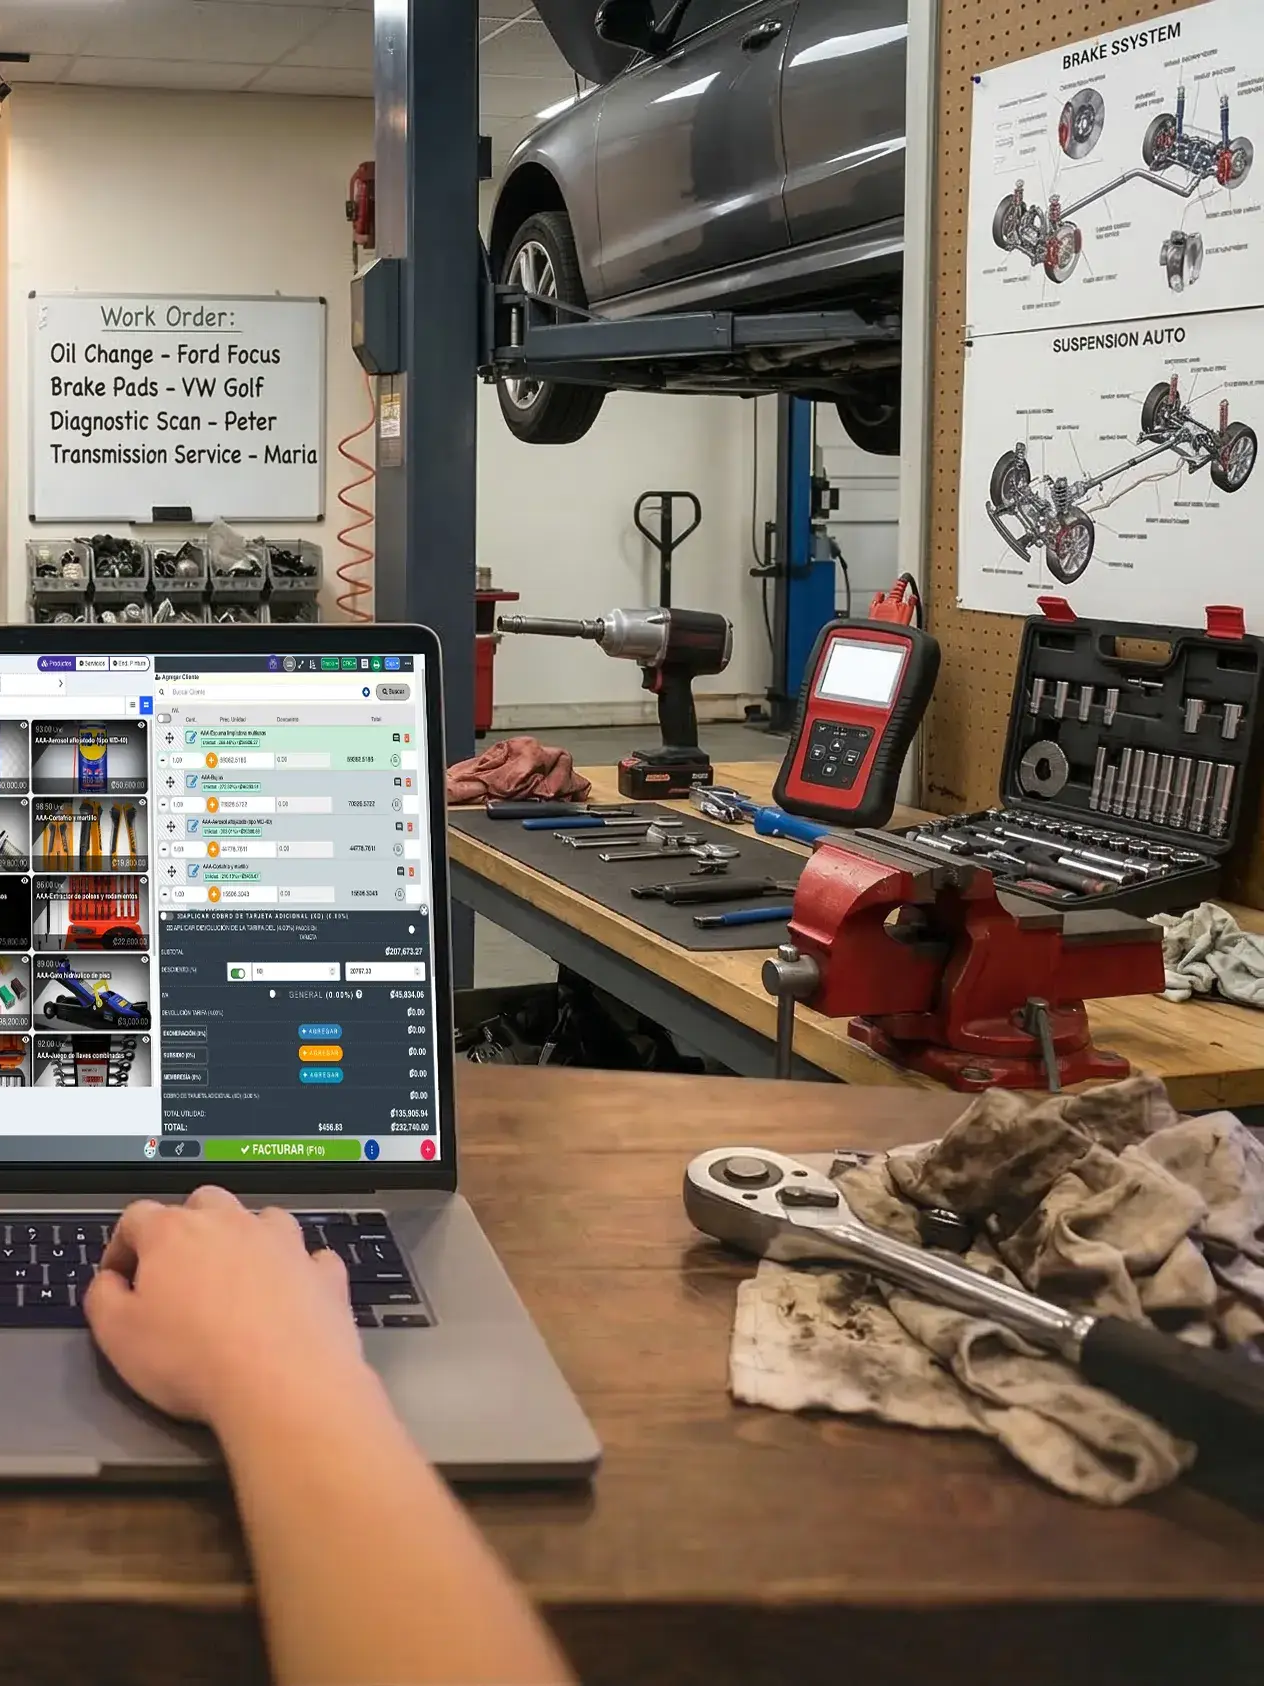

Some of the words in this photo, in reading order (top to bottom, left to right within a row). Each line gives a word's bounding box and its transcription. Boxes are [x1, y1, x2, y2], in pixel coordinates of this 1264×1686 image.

[1063, 40, 1108, 70] BRAKE
[1111, 22, 1181, 56] SSYSTEM
[101, 305, 155, 327] Work
[166, 306, 235, 327] Order:
[1053, 332, 1139, 353] SUSPENSION
[1143, 327, 1186, 345] AUTO
[51, 343, 76, 364] Oil
[85, 344, 154, 370] Change
[178, 344, 220, 364] Ford
[228, 345, 281, 364] Focus
[51, 376, 106, 397] Brake
[113, 376, 158, 397] Pads
[182, 377, 216, 397] VW
[224, 377, 265, 398] Golf
[50, 410, 149, 437] Diagnostic
[157, 411, 201, 431] Scan
[225, 410, 277, 431] Peter
[50, 443, 167, 464] Transmission
[175, 443, 242, 464] Service
[264, 444, 318, 464] Maria
[164, 1123, 188, 1131] TOTAL:
[252, 1143, 304, 1155] FACTURAR
[306, 1145, 325, 1157] (F10)
